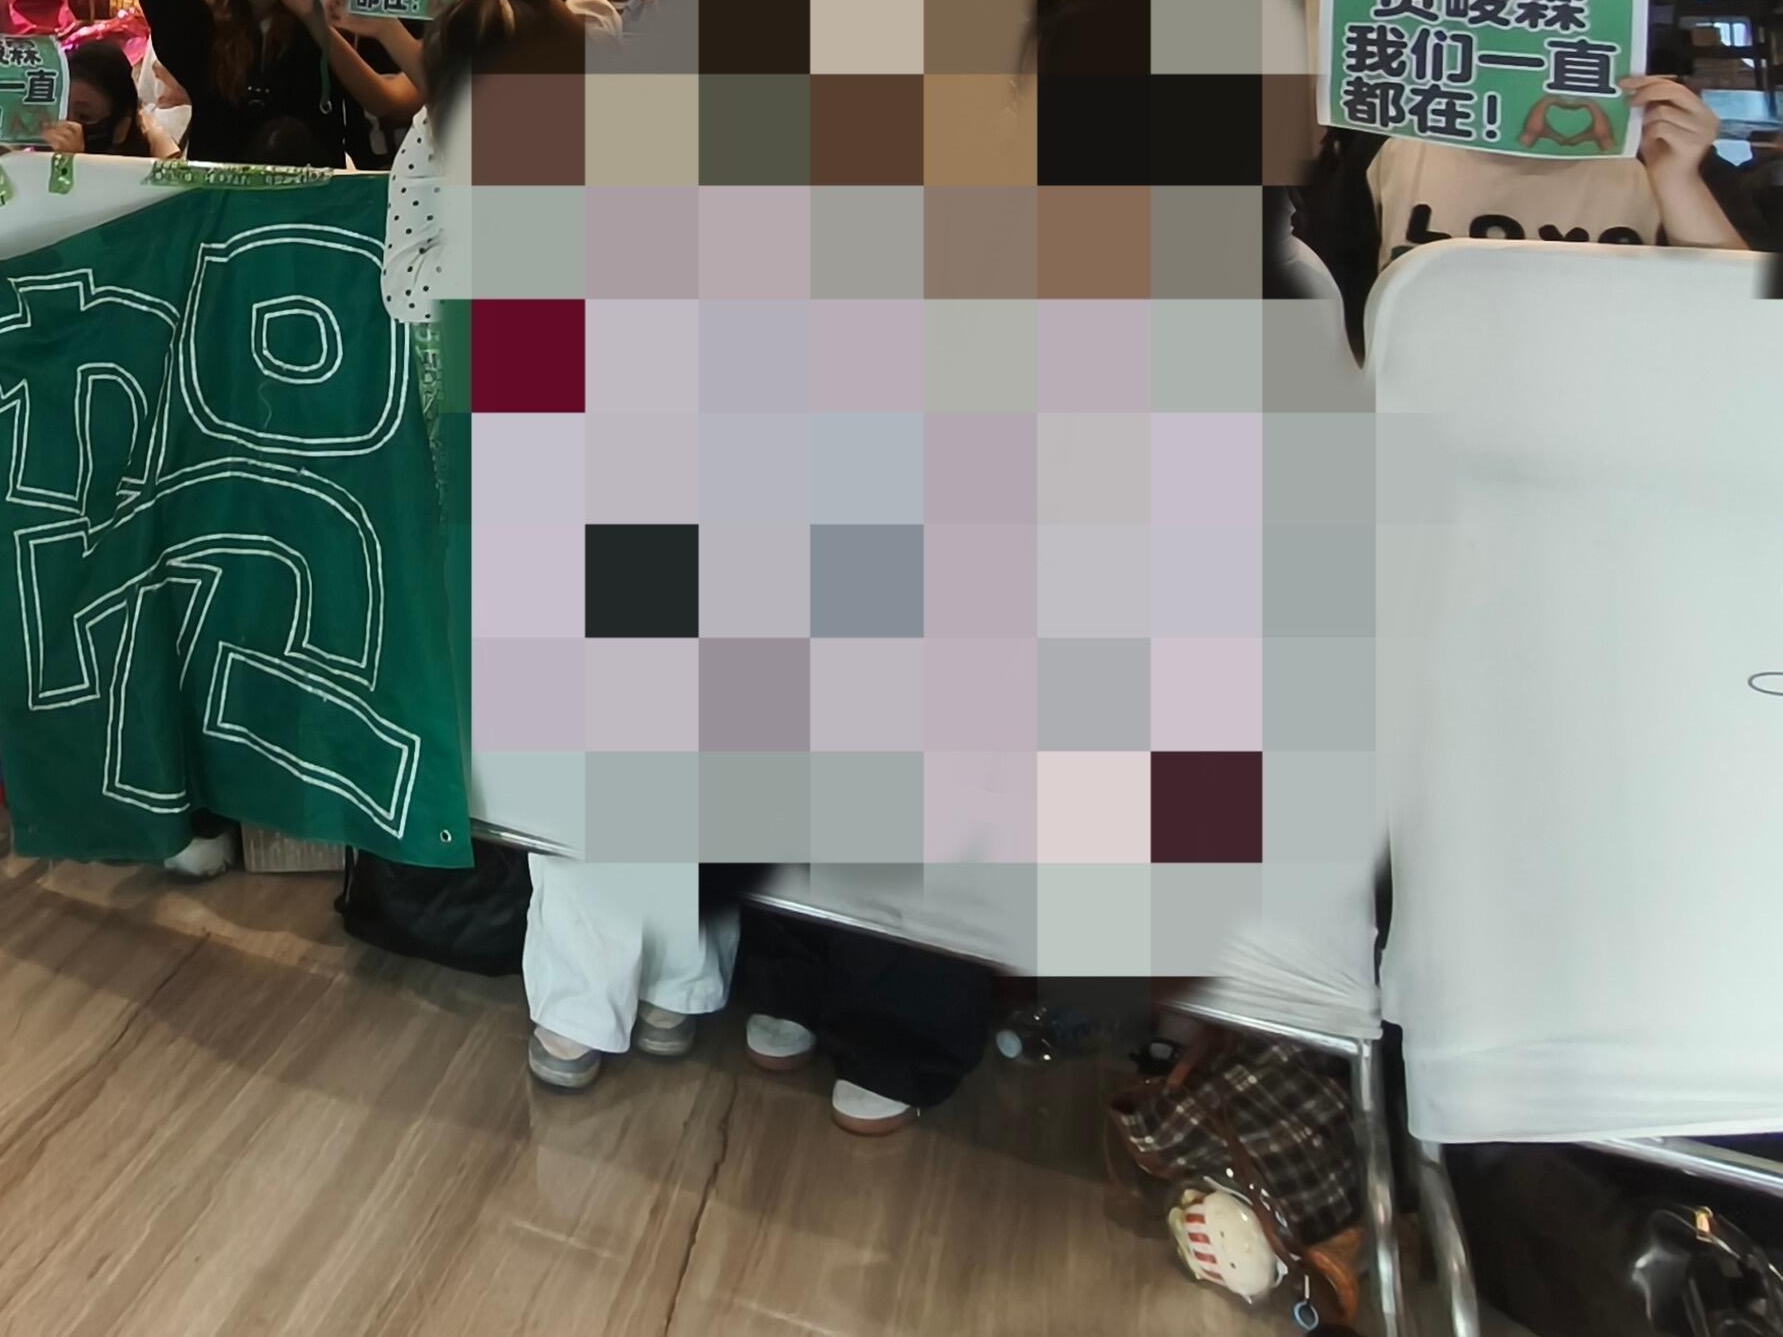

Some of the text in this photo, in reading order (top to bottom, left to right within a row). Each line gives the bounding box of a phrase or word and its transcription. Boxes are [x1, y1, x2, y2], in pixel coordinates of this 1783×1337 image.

[1342, 24, 1620, 96] 我们一直
[1341, 76, 1500, 139] 都在!
